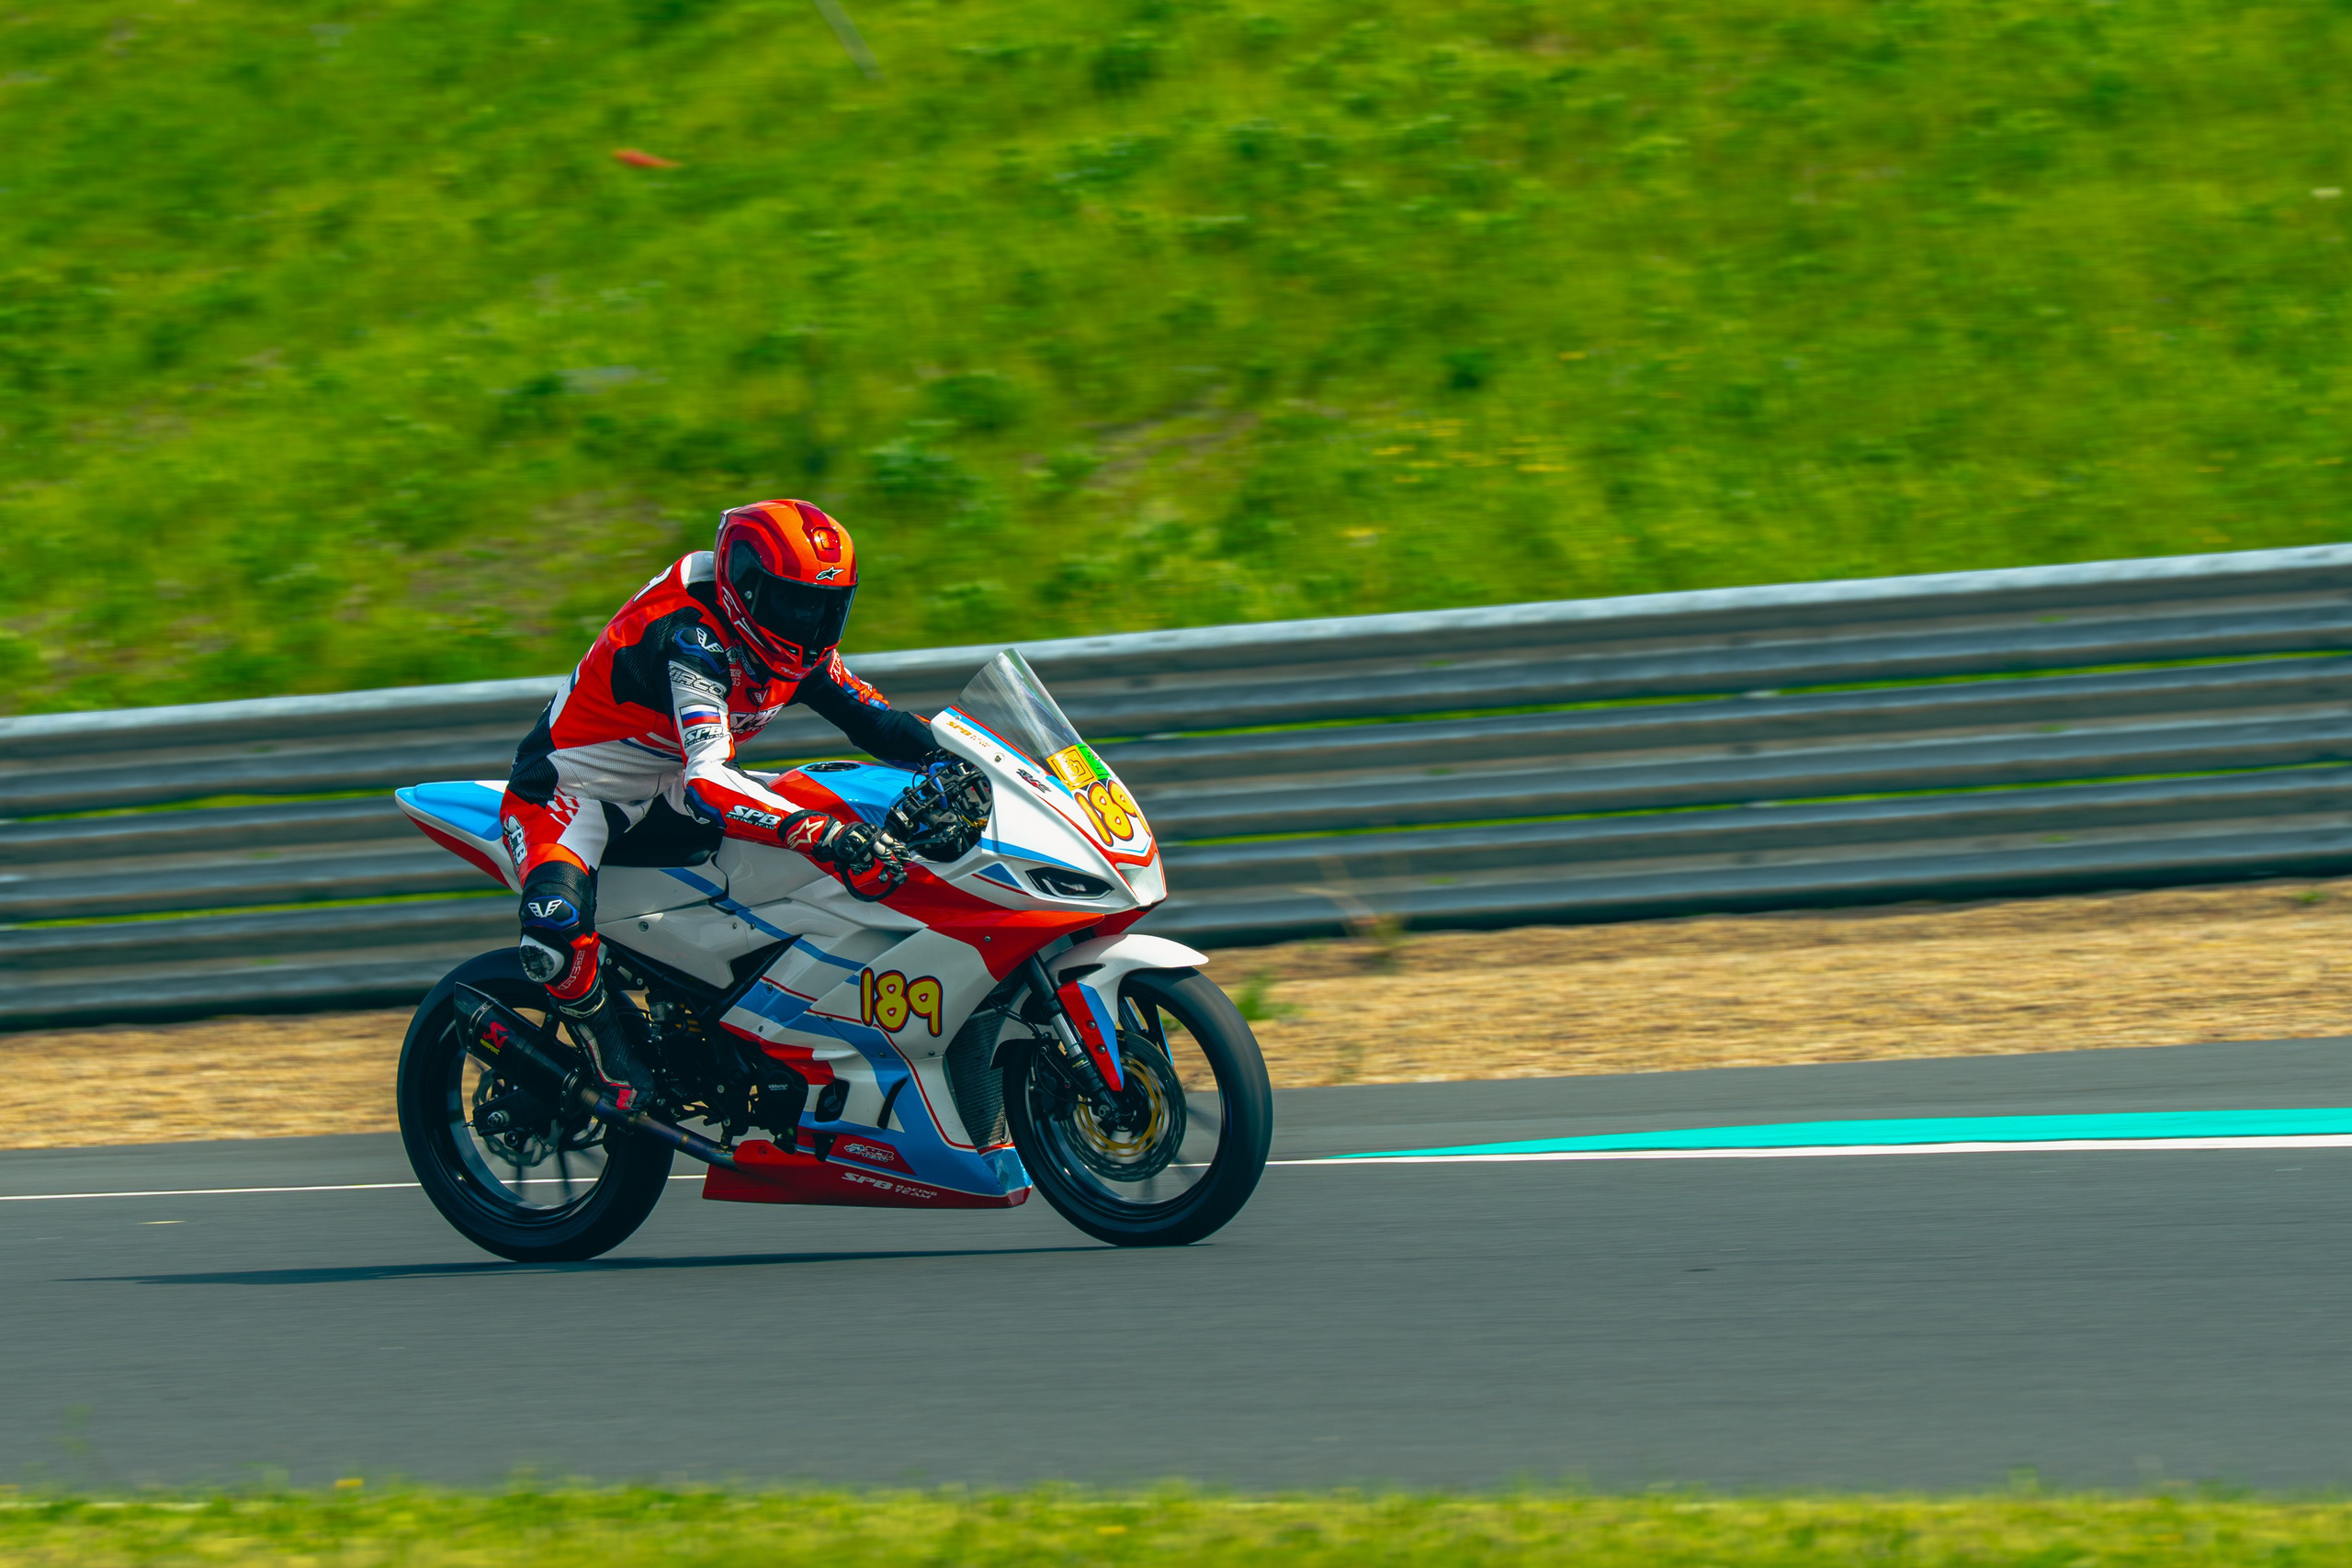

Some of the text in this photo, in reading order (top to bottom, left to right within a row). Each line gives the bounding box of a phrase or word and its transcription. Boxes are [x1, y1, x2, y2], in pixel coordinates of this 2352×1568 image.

[684, 725, 724, 743] SPB
[726, 814, 752, 825] RACING
[729, 805, 782, 826] SPB
[1074, 780, 1151, 847] 189
[860, 967, 943, 1037] 189
[842, 1172, 893, 1190] SPB
[895, 1184, 937, 1196] RACING
[894, 1188, 932, 1199] TEAM
